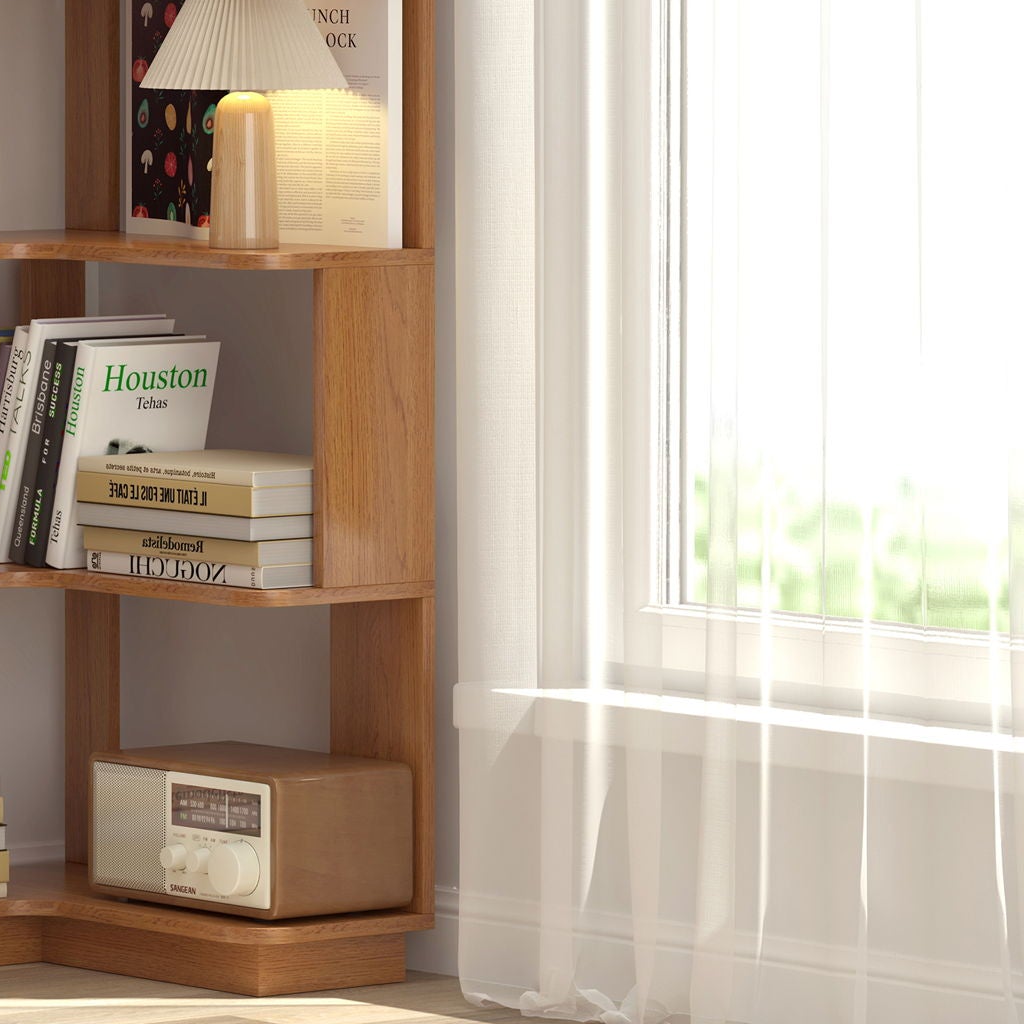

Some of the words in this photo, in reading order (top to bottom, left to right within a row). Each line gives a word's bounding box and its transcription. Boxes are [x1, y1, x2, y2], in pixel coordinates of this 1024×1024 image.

[9, 350, 32, 434] TALKS
[31, 360, 52, 436] Brisbane
[65, 366, 86, 437] Houston
[102, 363, 208, 393] Houston
[135, 395, 168, 410] Tehas
[0, 449, 12, 491] TED
[29, 488, 44, 546] FORMULA
[42, 437, 51, 464] FOR
[48, 362, 63, 419] SUCCESS
[15, 485, 30, 548] Queensland
[50, 509, 63, 546] Tehas
[169, 883, 197, 895] SANGEAN
